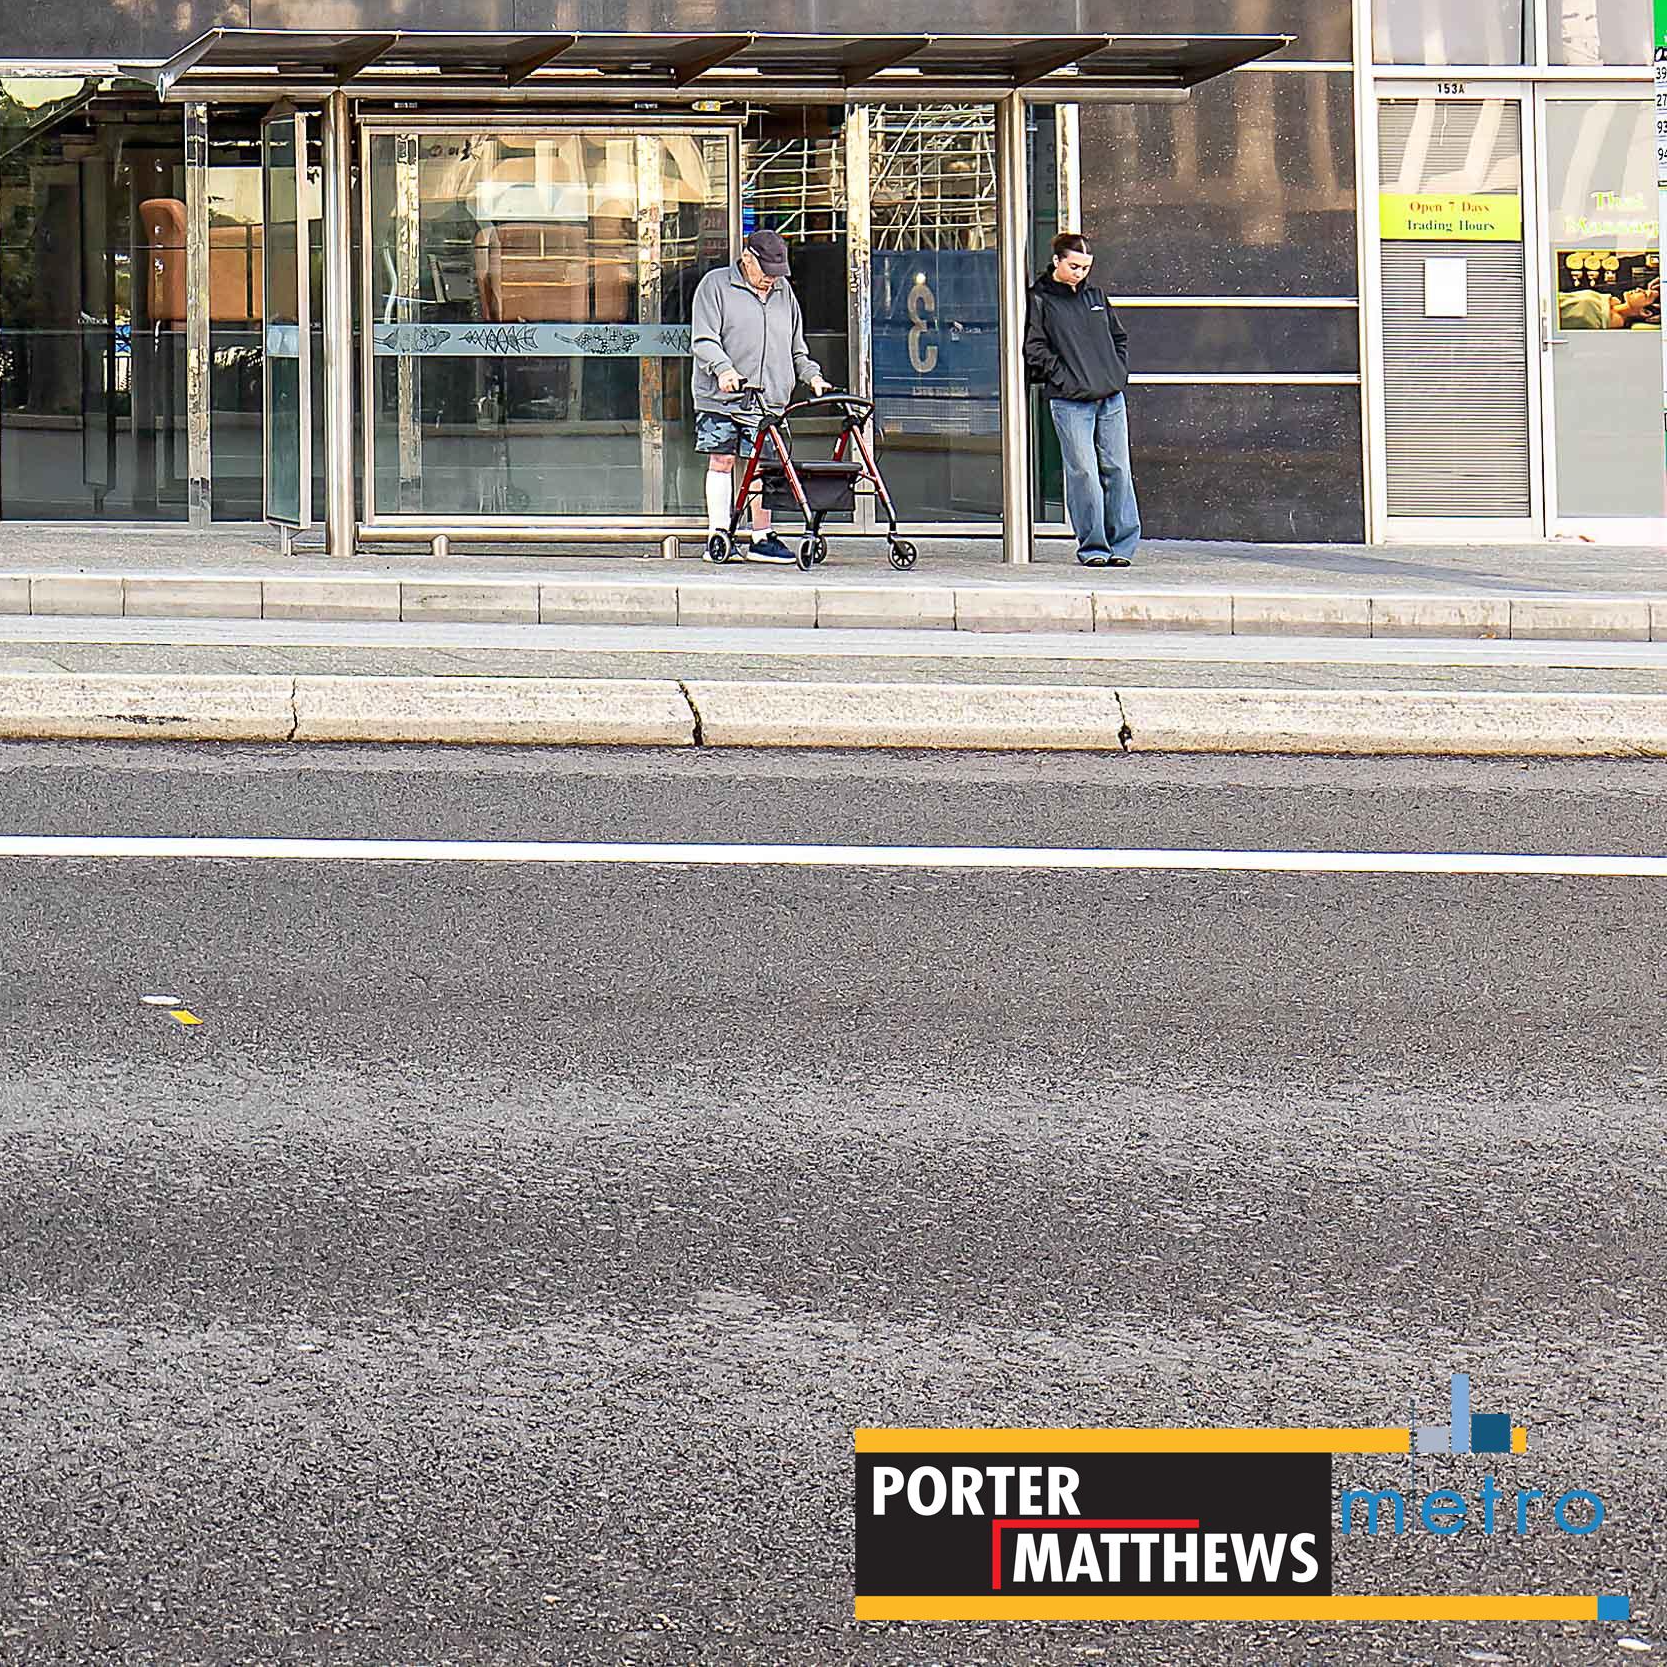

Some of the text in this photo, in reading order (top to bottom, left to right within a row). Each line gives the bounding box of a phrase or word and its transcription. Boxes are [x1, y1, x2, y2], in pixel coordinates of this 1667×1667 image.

[1437, 83, 1465, 94] 153A
[1409, 201, 1490, 214] Open 7 Days
[1407, 219, 1496, 232] Trading Hours
